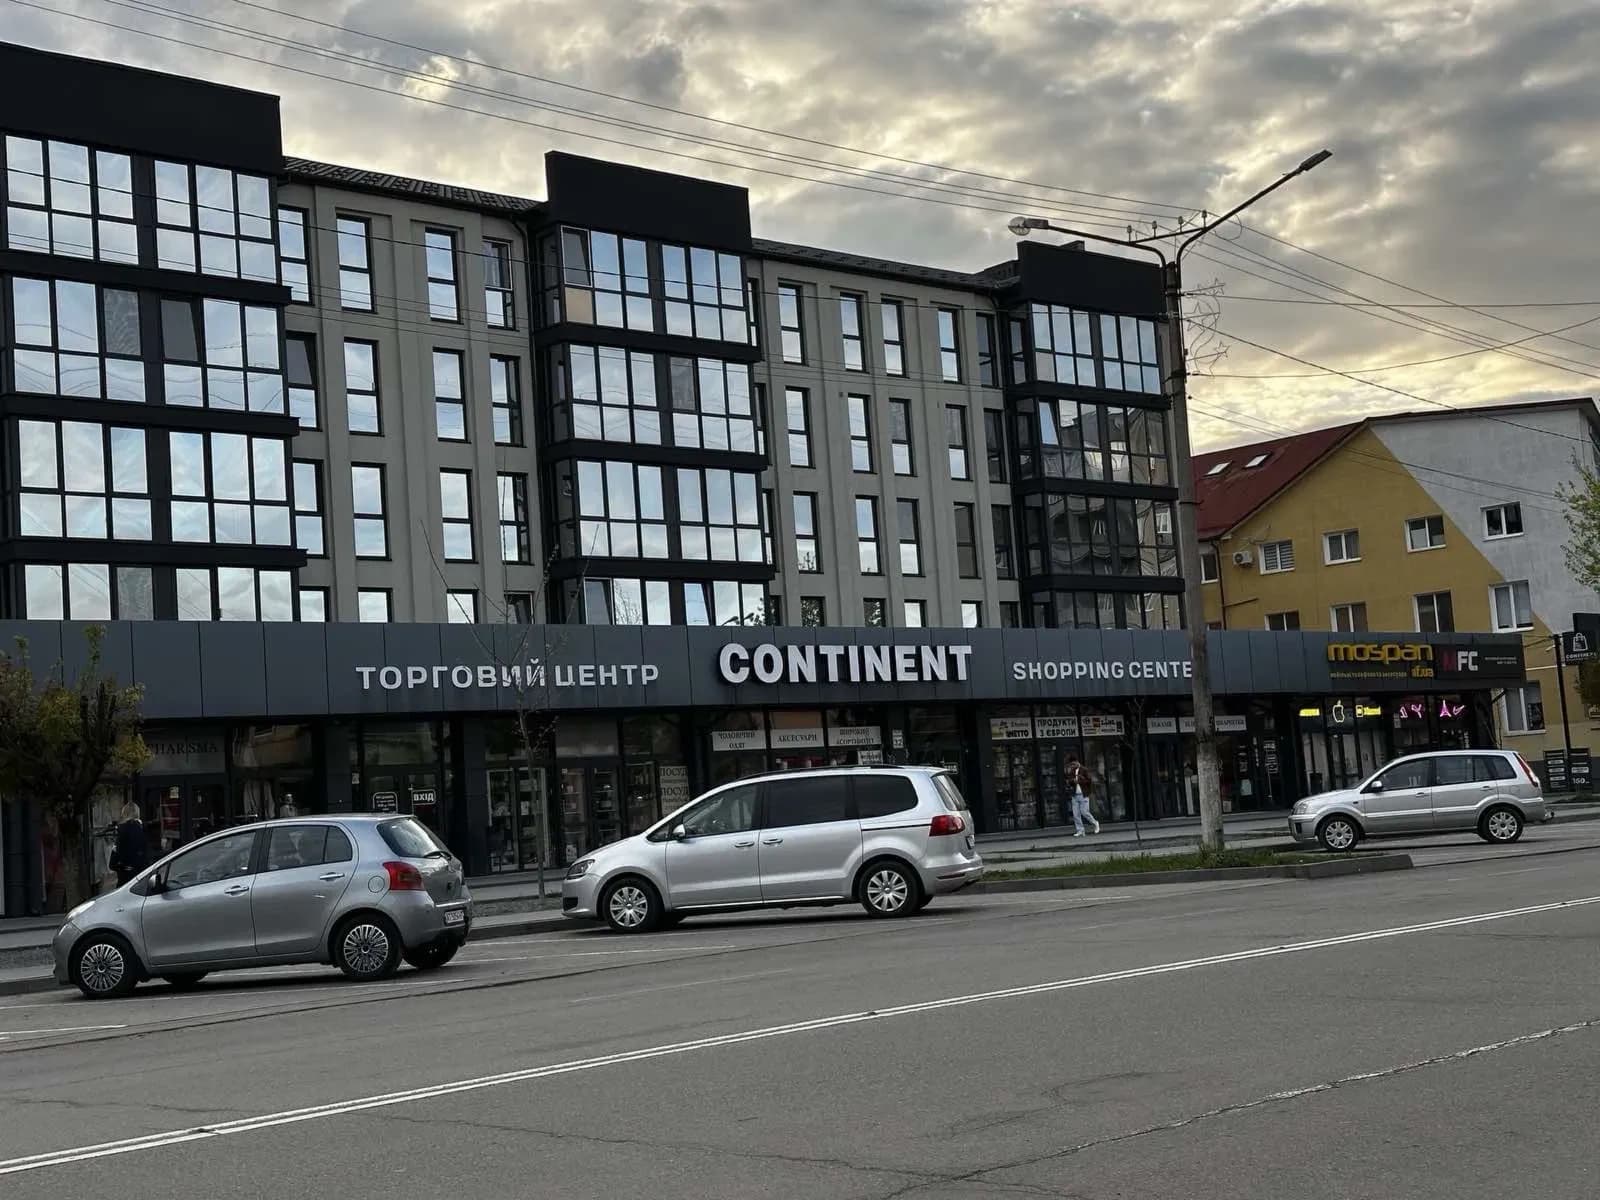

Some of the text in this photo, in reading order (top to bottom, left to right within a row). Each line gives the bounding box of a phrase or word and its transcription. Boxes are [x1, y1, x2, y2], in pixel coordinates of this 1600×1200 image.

[719, 643, 972, 683] CONTINENT
[1328, 643, 1433, 664] mospan
[355, 658, 659, 689] ТОРГОВИЙ ЦЕНТР
[1013, 661, 1192, 680] SHOPPING CENTE
[1037, 718, 1076, 728] ПРОДУКТИ
[1046, 728, 1076, 737] ЄВРОПИ
